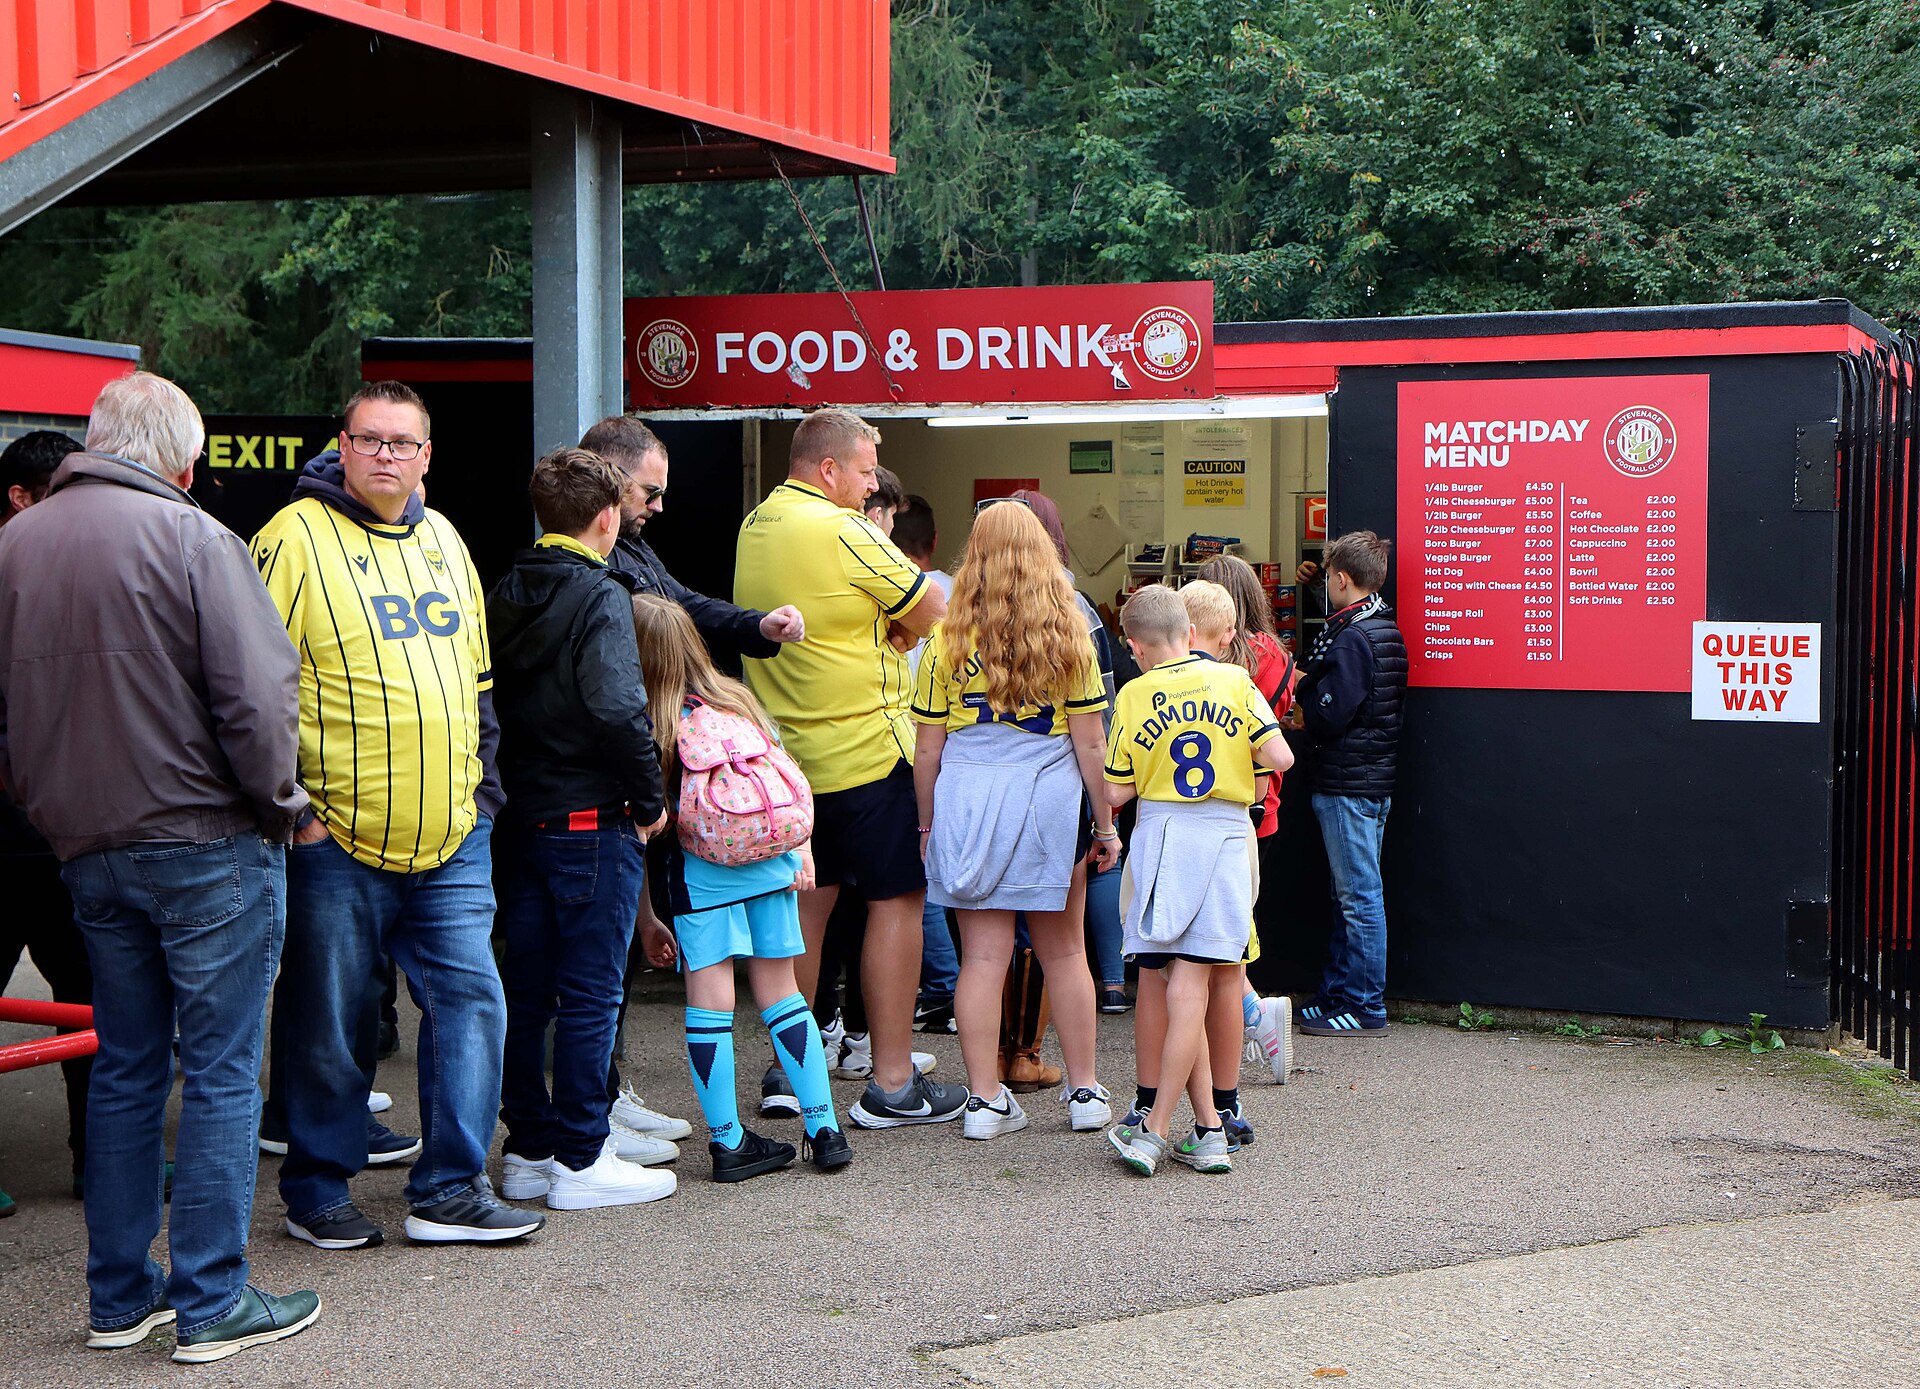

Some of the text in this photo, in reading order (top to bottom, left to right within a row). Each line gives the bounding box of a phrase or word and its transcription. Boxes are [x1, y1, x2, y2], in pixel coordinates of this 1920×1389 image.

[1143, 311, 1187, 326] STEVENAGE
[647, 324, 685, 337] STEVENAGE
[716, 324, 1115, 374] FOOD & DRINK
[1143, 360, 1190, 376] FOOTBALL CLUB
[649, 369, 677, 383] FOOTBALL
[1618, 410, 1663, 425] STEVENAGE
[1424, 419, 1590, 444] MATCHDAY
[208, 434, 303, 471] EXIT
[1424, 444, 1510, 468] MENU
[1187, 462, 1242, 473] CAUTION
[1616, 457, 1664, 473] FOOTBALL CLUB
[1195, 479, 1234, 487] Hot Drinks
[1424, 482, 1554, 493] 1/4lb Burger £4.50
[1185, 488, 1213, 496] contain
[1213, 489, 1230, 497] very
[1424, 496, 1554, 507] 1/4lb Cheeseburger £5.00
[1569, 495, 1677, 505] Tea £2.00
[1424, 510, 1554, 521] 1/2lb Burger £5.50
[1569, 509, 1676, 519] Coffee £2.00
[1424, 524, 1554, 535] 1/2lb Cheeseburger £6.00
[1569, 524, 1676, 534] Hot Chocolate £2.00
[1424, 539, 1553, 549] Boro Burger £7.00
[1569, 538, 1676, 549] Cappuccino £2.00
[1424, 552, 1553, 563] Veggie Burger £4.00
[1569, 553, 1676, 562] Latte £2.00
[1424, 567, 1553, 577] Hot Dog £4.00
[1569, 567, 1676, 577] Bovril £2.00
[1424, 581, 1553, 591] Hot Dog with Cheese £4.50
[1569, 581, 1676, 591] Bottled Water £2.00
[1424, 594, 1553, 605] Pies £4.00
[1569, 595, 1675, 605] Soft Drinks £2.50
[369, 591, 461, 641] BG
[1424, 608, 1553, 619] Sausage Roll £3.00
[1424, 622, 1553, 633] Chips £3.00
[1424, 636, 1553, 647] Chocolate Bars £1.50
[1702, 634, 1811, 658] QUEUE
[1424, 650, 1553, 661] Crisps £1.50
[1717, 662, 1793, 685] THIS
[1168, 687, 1201, 700] Polythene
[1201, 684, 1212, 692] UK
[1721, 688, 1789, 712] WAY
[1133, 700, 1244, 752] EDMONDS
[1169, 730, 1216, 799] 8
